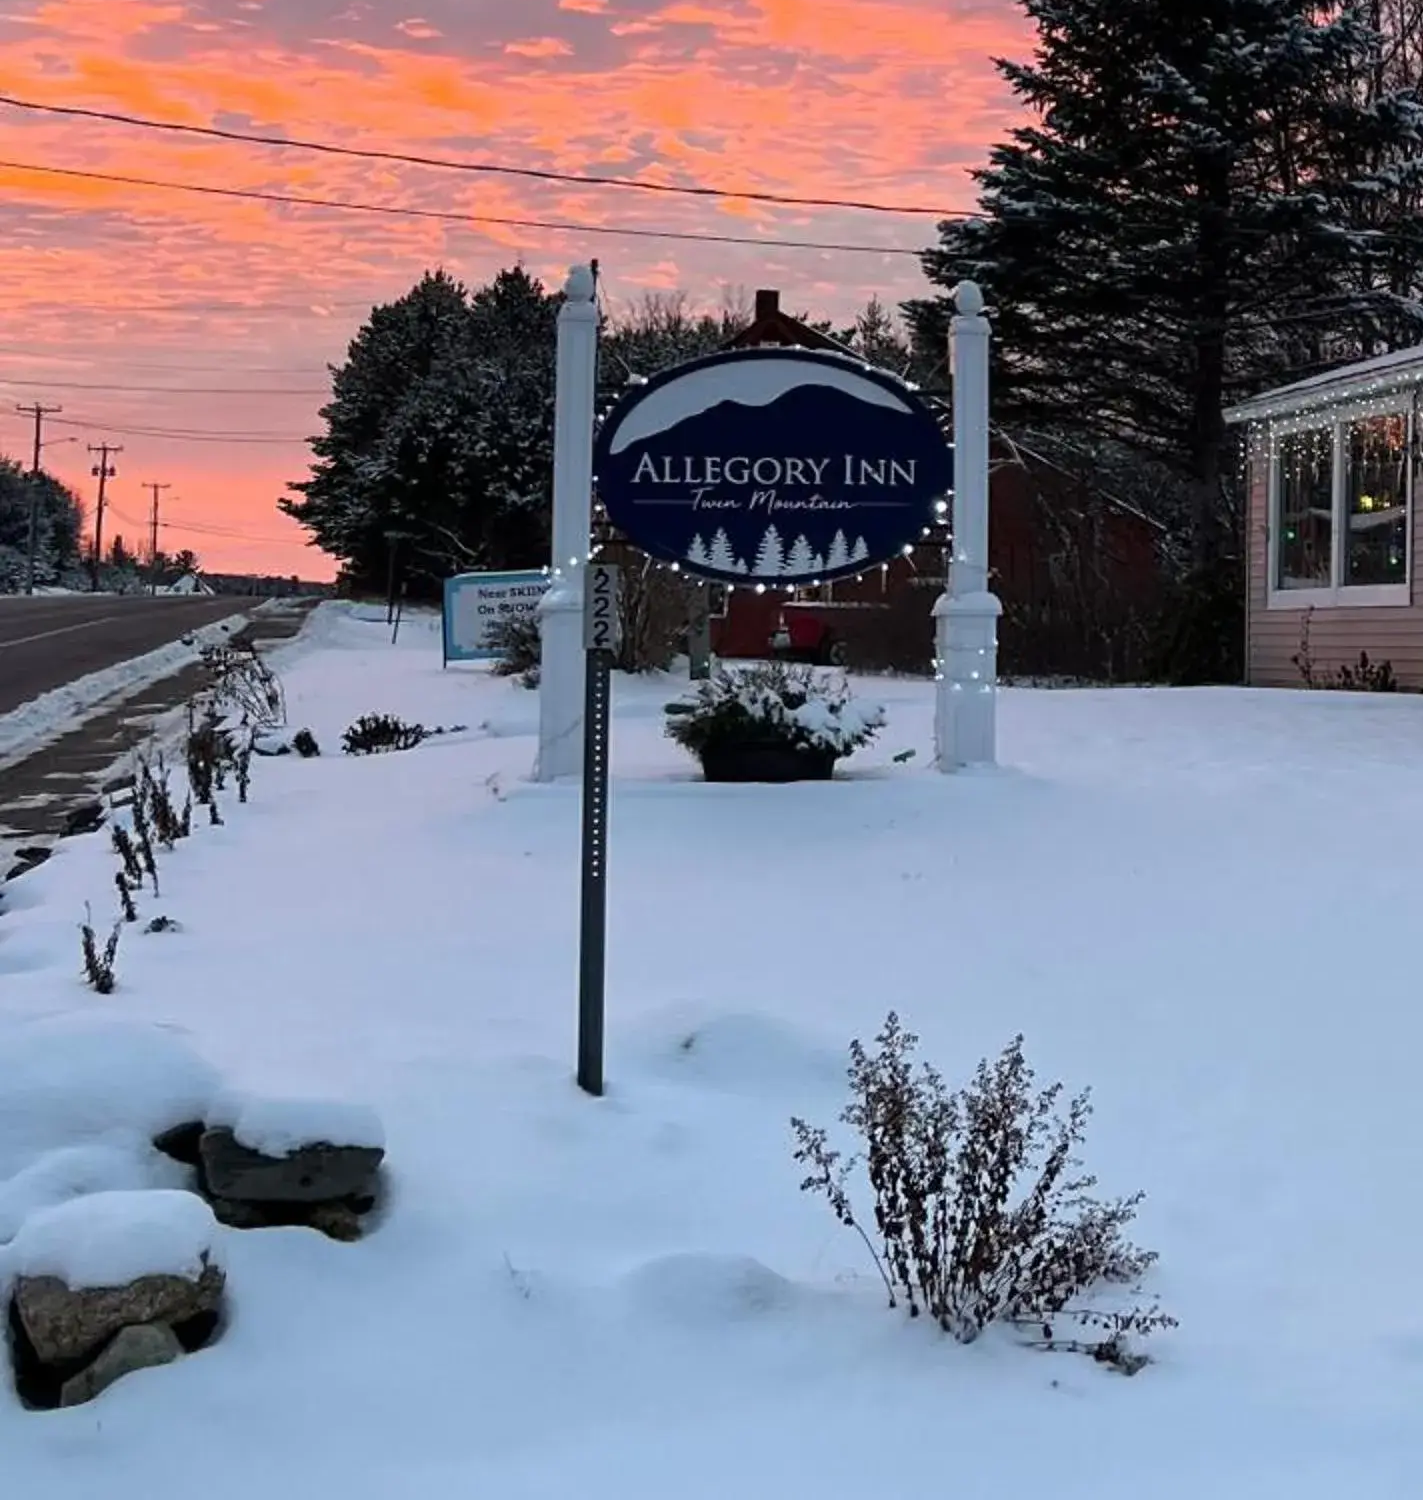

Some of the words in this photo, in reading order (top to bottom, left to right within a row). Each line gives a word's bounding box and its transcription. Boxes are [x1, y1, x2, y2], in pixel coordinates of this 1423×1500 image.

[630, 451, 831, 485] ALLEGORY
[844, 454, 918, 485] INN
[690, 486, 742, 511] Twin
[749, 489, 853, 515] Mountain
[594, 571, 610, 643] 222
